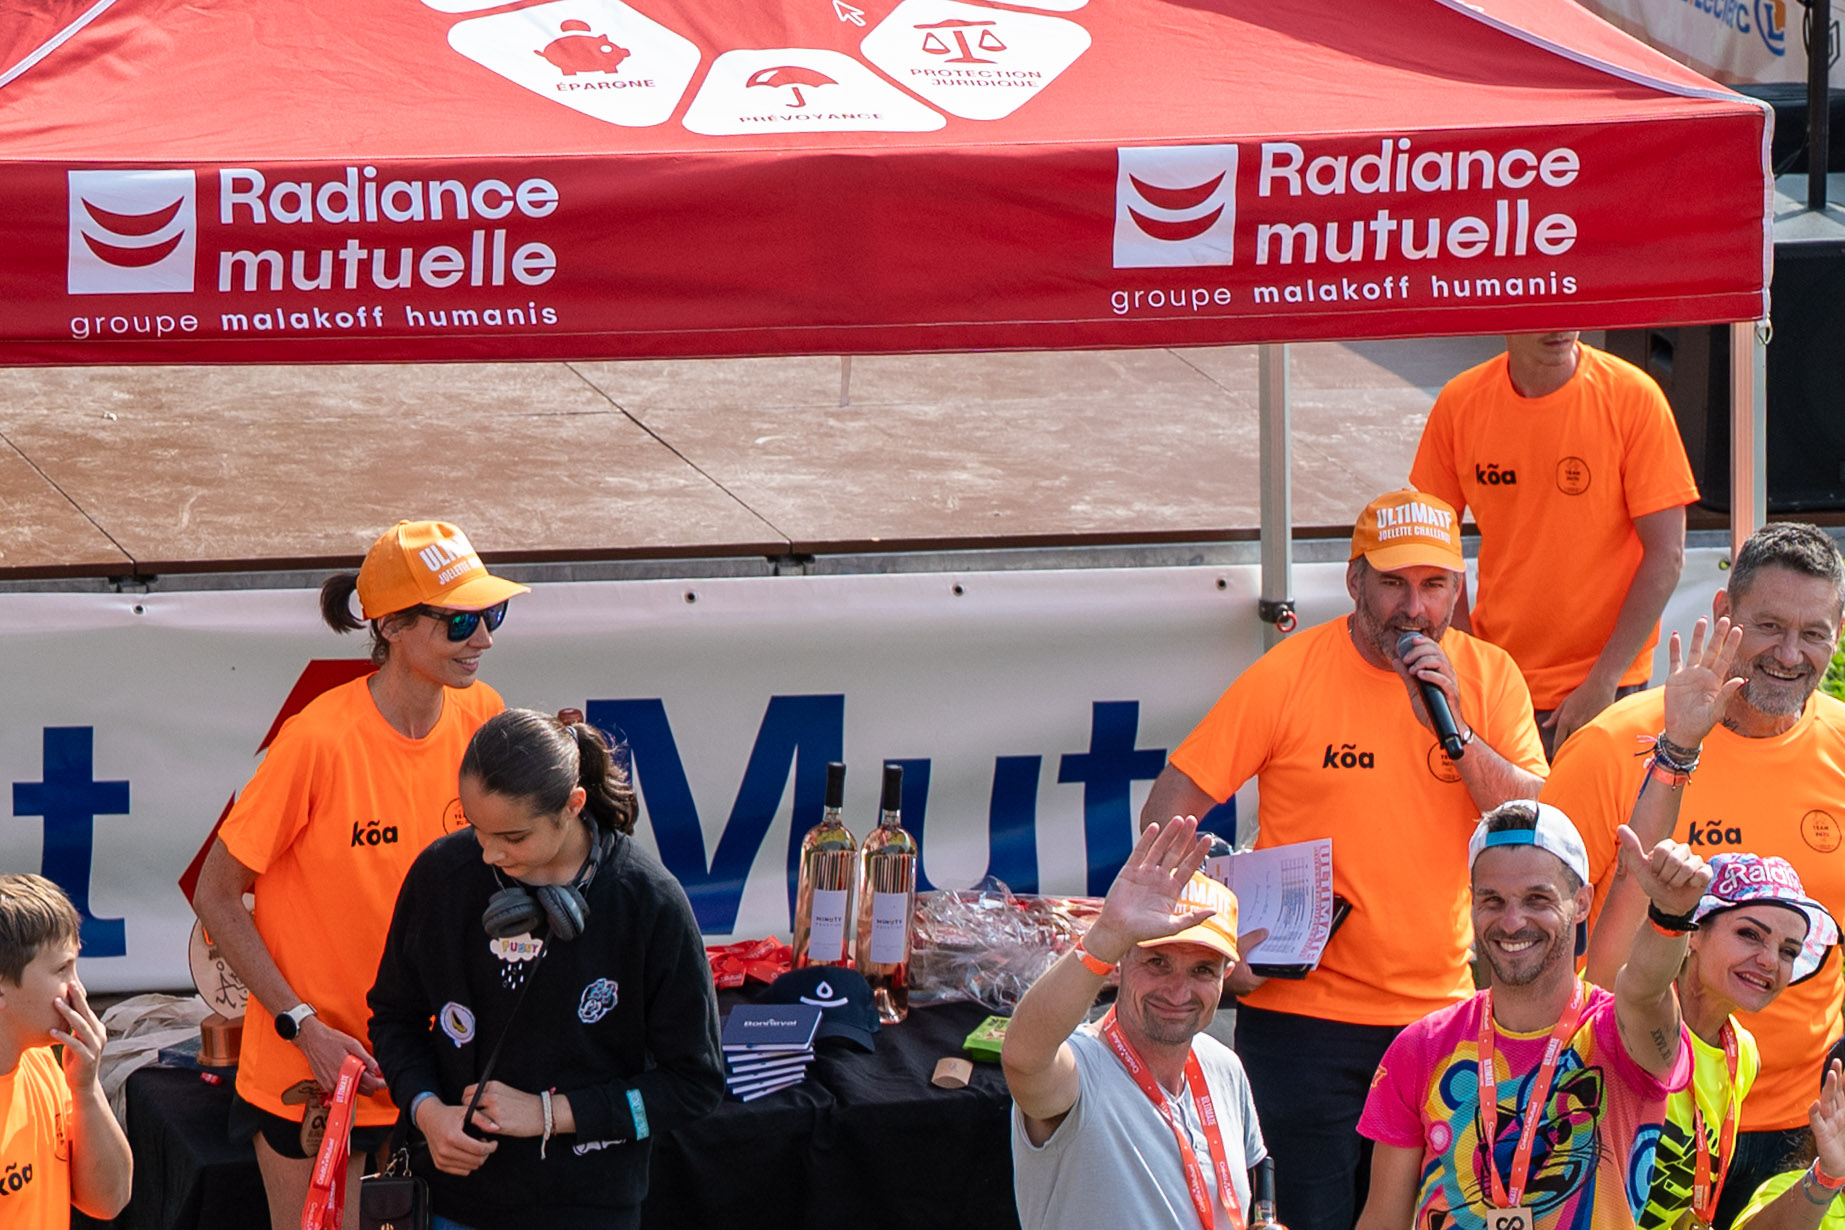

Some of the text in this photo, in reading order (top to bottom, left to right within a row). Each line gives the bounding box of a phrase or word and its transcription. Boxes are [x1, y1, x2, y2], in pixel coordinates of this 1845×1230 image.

[556, 79, 657, 92] ÉPARGNE
[910, 68, 1042, 79] PROTECTION
[930, 79, 1039, 89] JURIDIQUE
[739, 113, 884, 123] PRÉVOYANCE
[1258, 138, 1581, 197] Radiance
[219, 167, 560, 224] Radiance
[1255, 199, 1578, 266] mutuelle
[218, 229, 558, 292] mutuelle
[1111, 271, 1579, 315] groupe malakoff humanis
[70, 302, 559, 340] groupe malakoff humanis
[1475, 463, 1517, 486] kõa
[1322, 743, 1375, 769] kõa
[351, 819, 398, 847] kõa
[1688, 820, 1742, 846] kõa
